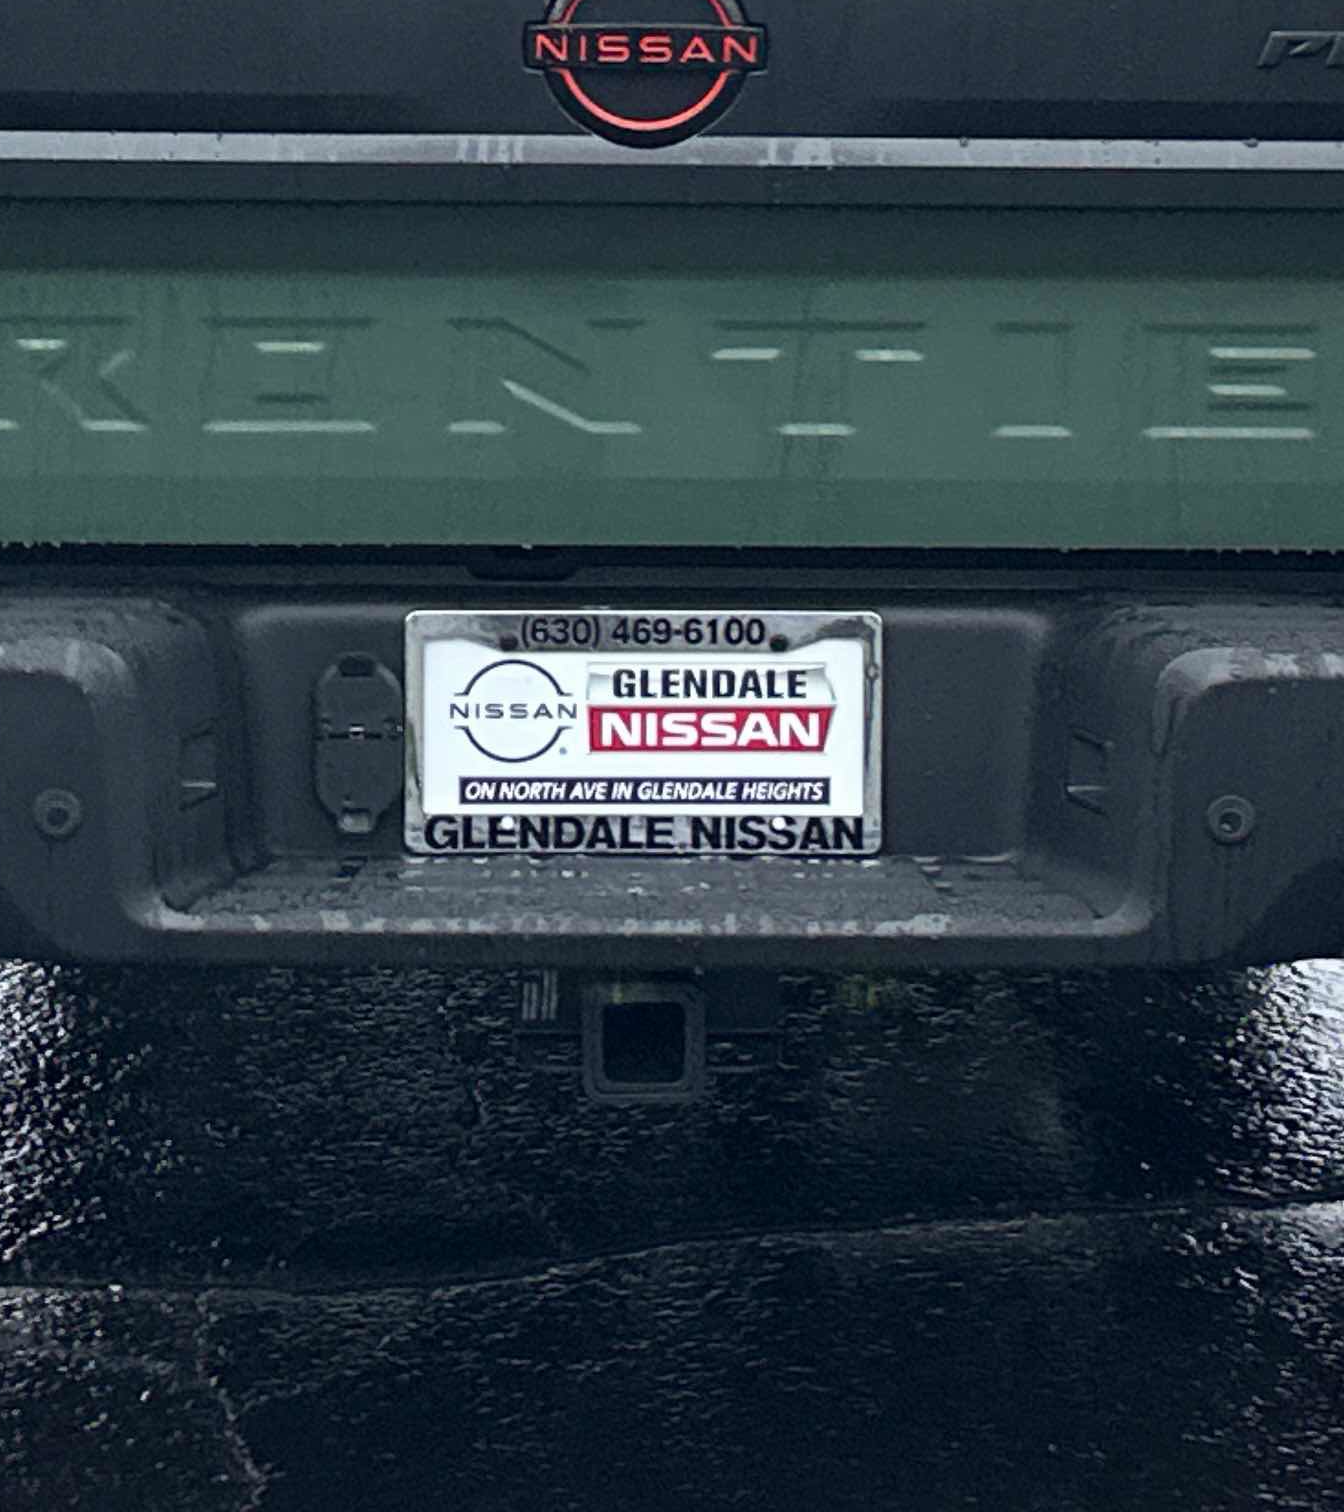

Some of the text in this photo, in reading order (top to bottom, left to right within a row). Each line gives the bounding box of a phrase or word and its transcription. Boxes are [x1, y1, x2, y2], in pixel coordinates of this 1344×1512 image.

[535, 33, 759, 64] NISSAN
[520, 615, 766, 647] (630) 469-6100
[612, 669, 808, 699] GLENDALE
[449, 703, 578, 720] NISSAN
[601, 713, 821, 748] NISSAN
[464, 781, 825, 802] ON NORTH AVE IN GLENDALE HEIGHTS
[424, 816, 864, 851] GLENDALE NISSAN
